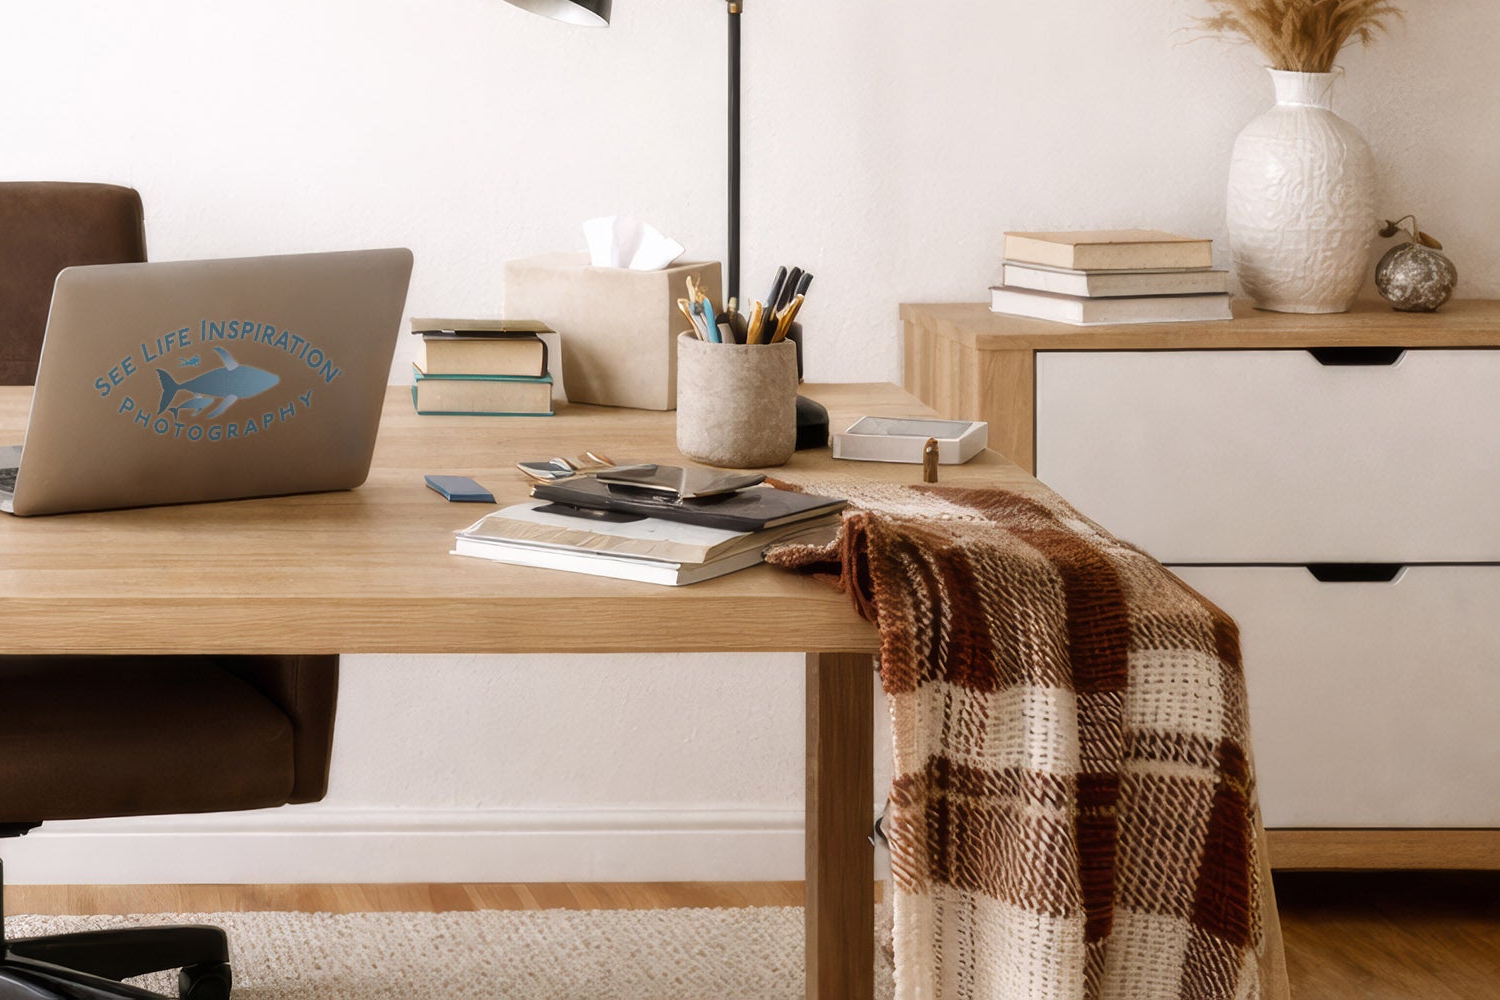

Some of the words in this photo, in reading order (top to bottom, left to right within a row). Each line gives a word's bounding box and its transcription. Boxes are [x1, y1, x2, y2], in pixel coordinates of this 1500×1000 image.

[94, 355, 138, 398] SEE
[141, 327, 192, 363] LIFE
[118, 389, 314, 441] PHOTOGRAPHY
